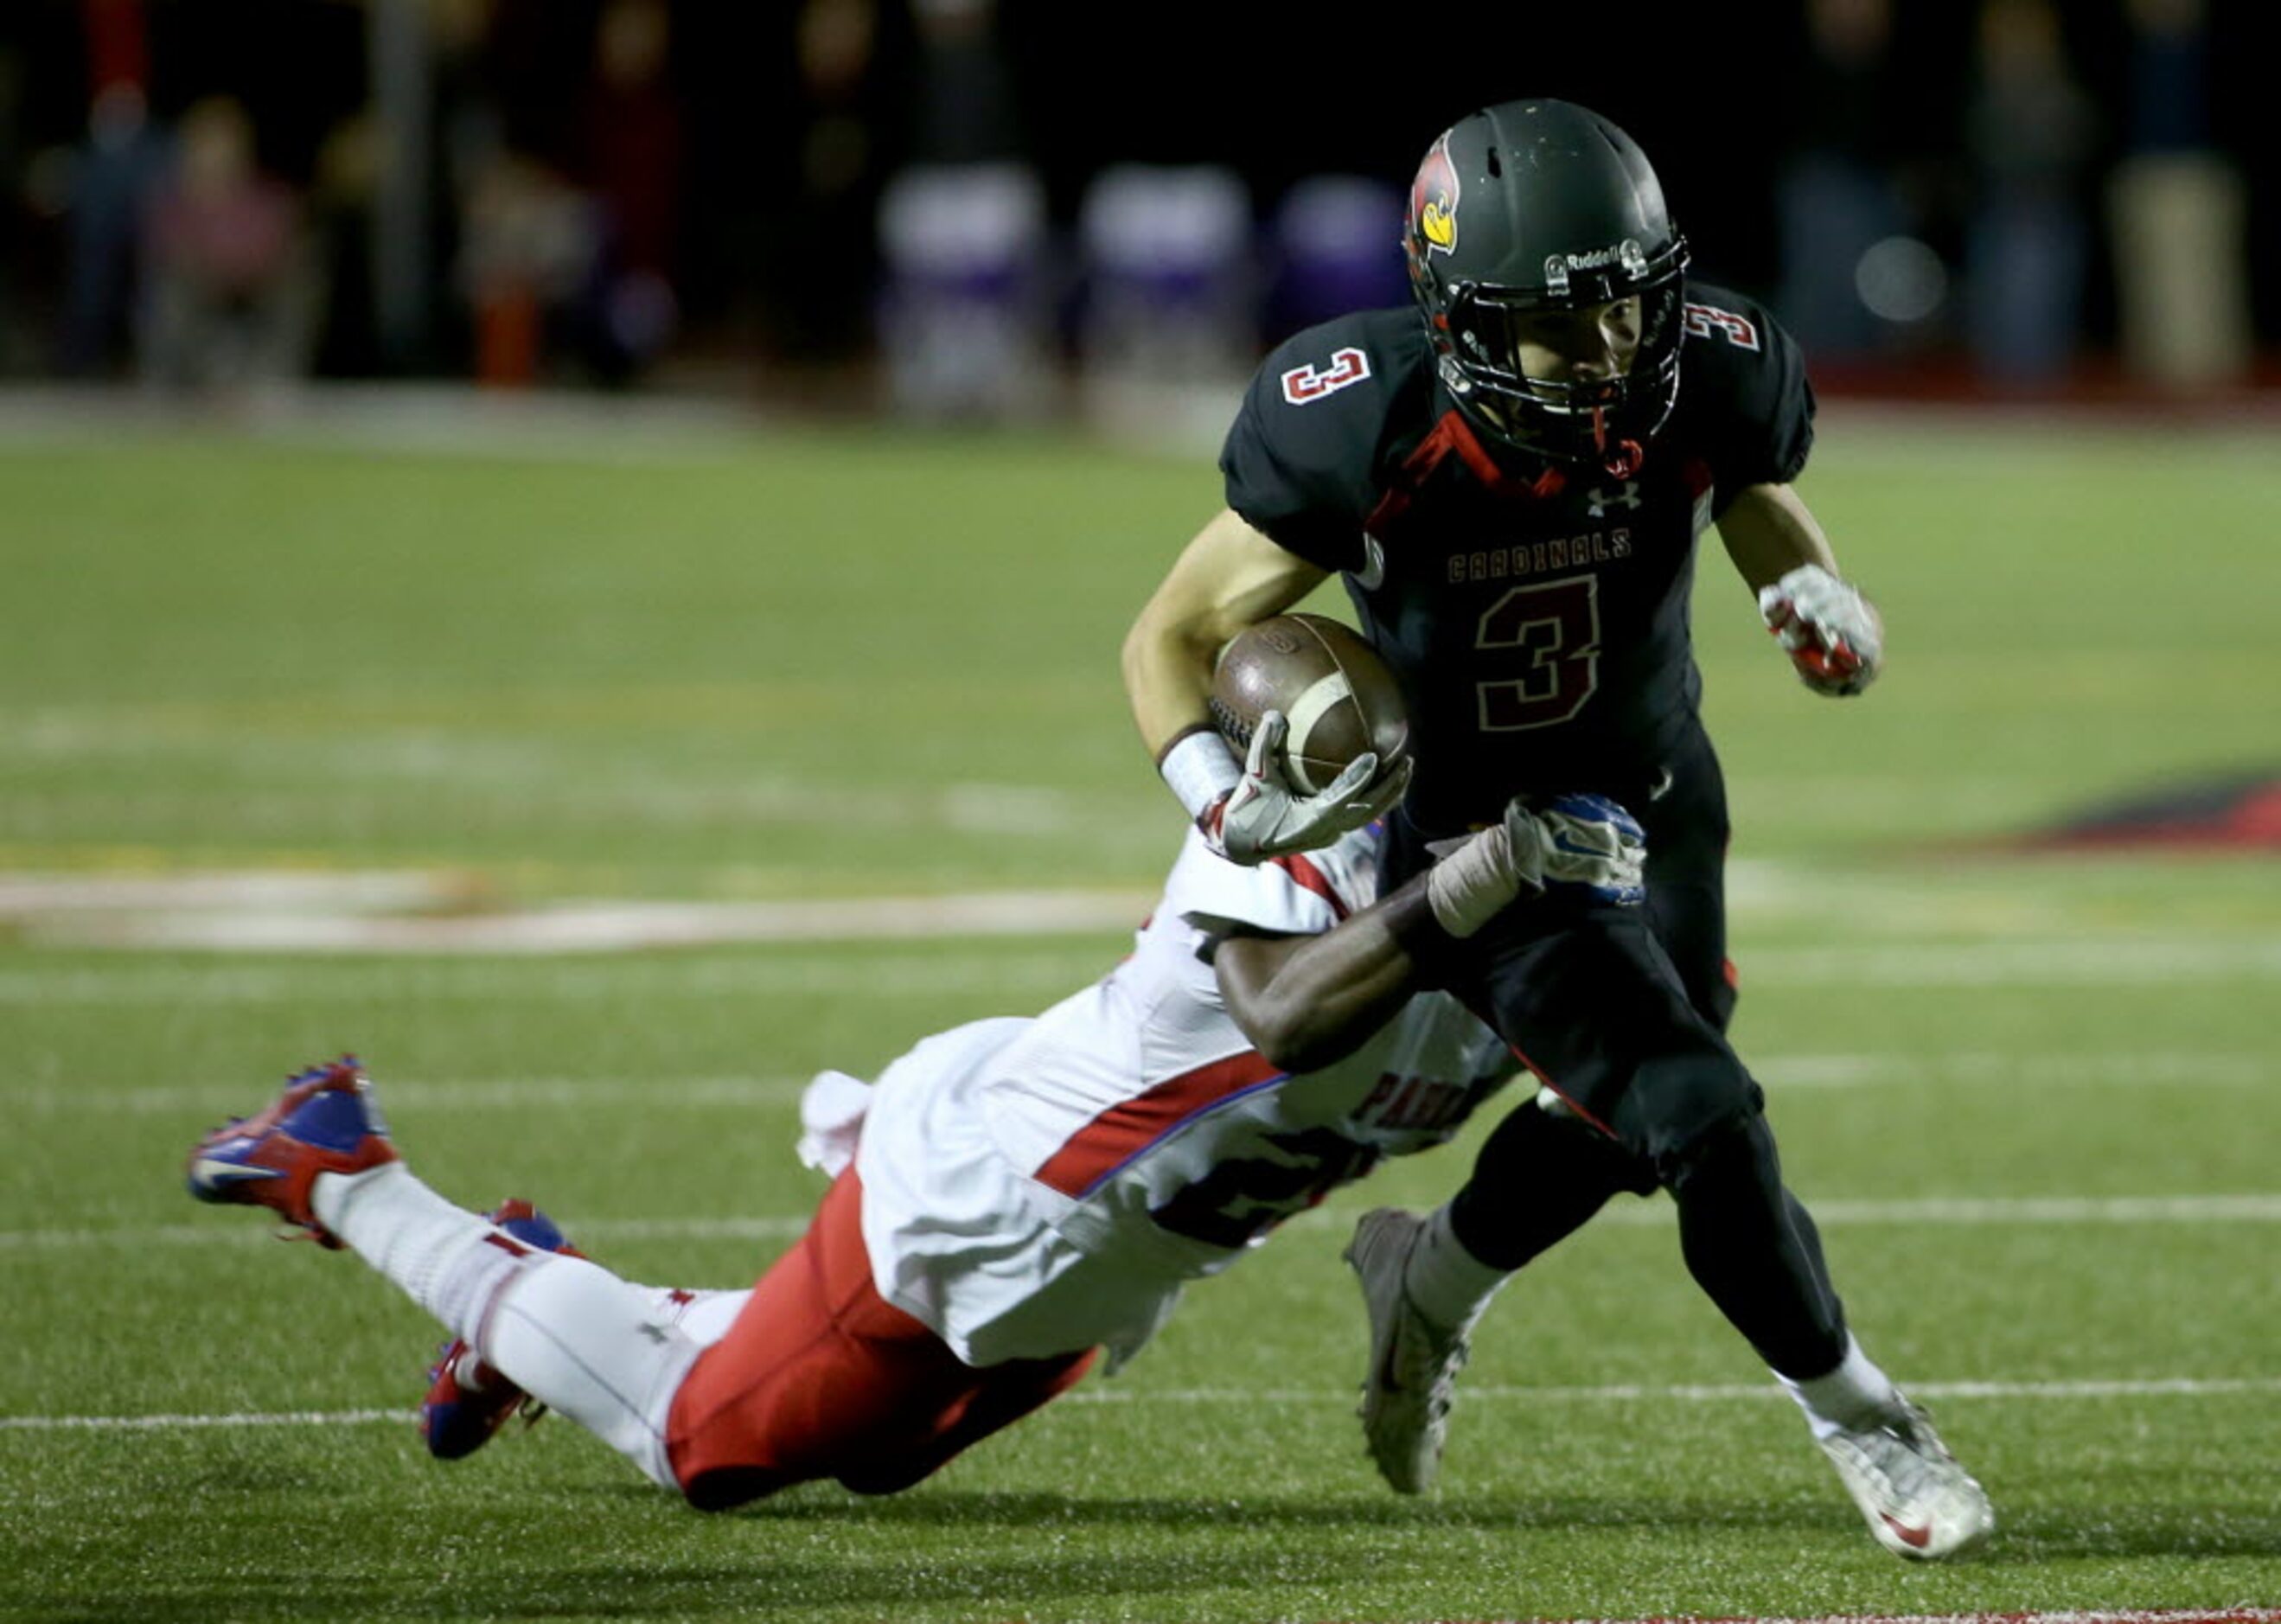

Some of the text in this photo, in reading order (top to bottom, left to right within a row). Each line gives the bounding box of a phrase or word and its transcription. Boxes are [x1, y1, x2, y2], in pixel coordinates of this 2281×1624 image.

[1566, 245, 1619, 271] Riddell
[1684, 303, 1760, 353] 3
[1281, 347, 1371, 406] 3
[1447, 527, 1633, 584] CARDINALS
[1475, 572, 1601, 732] 3
